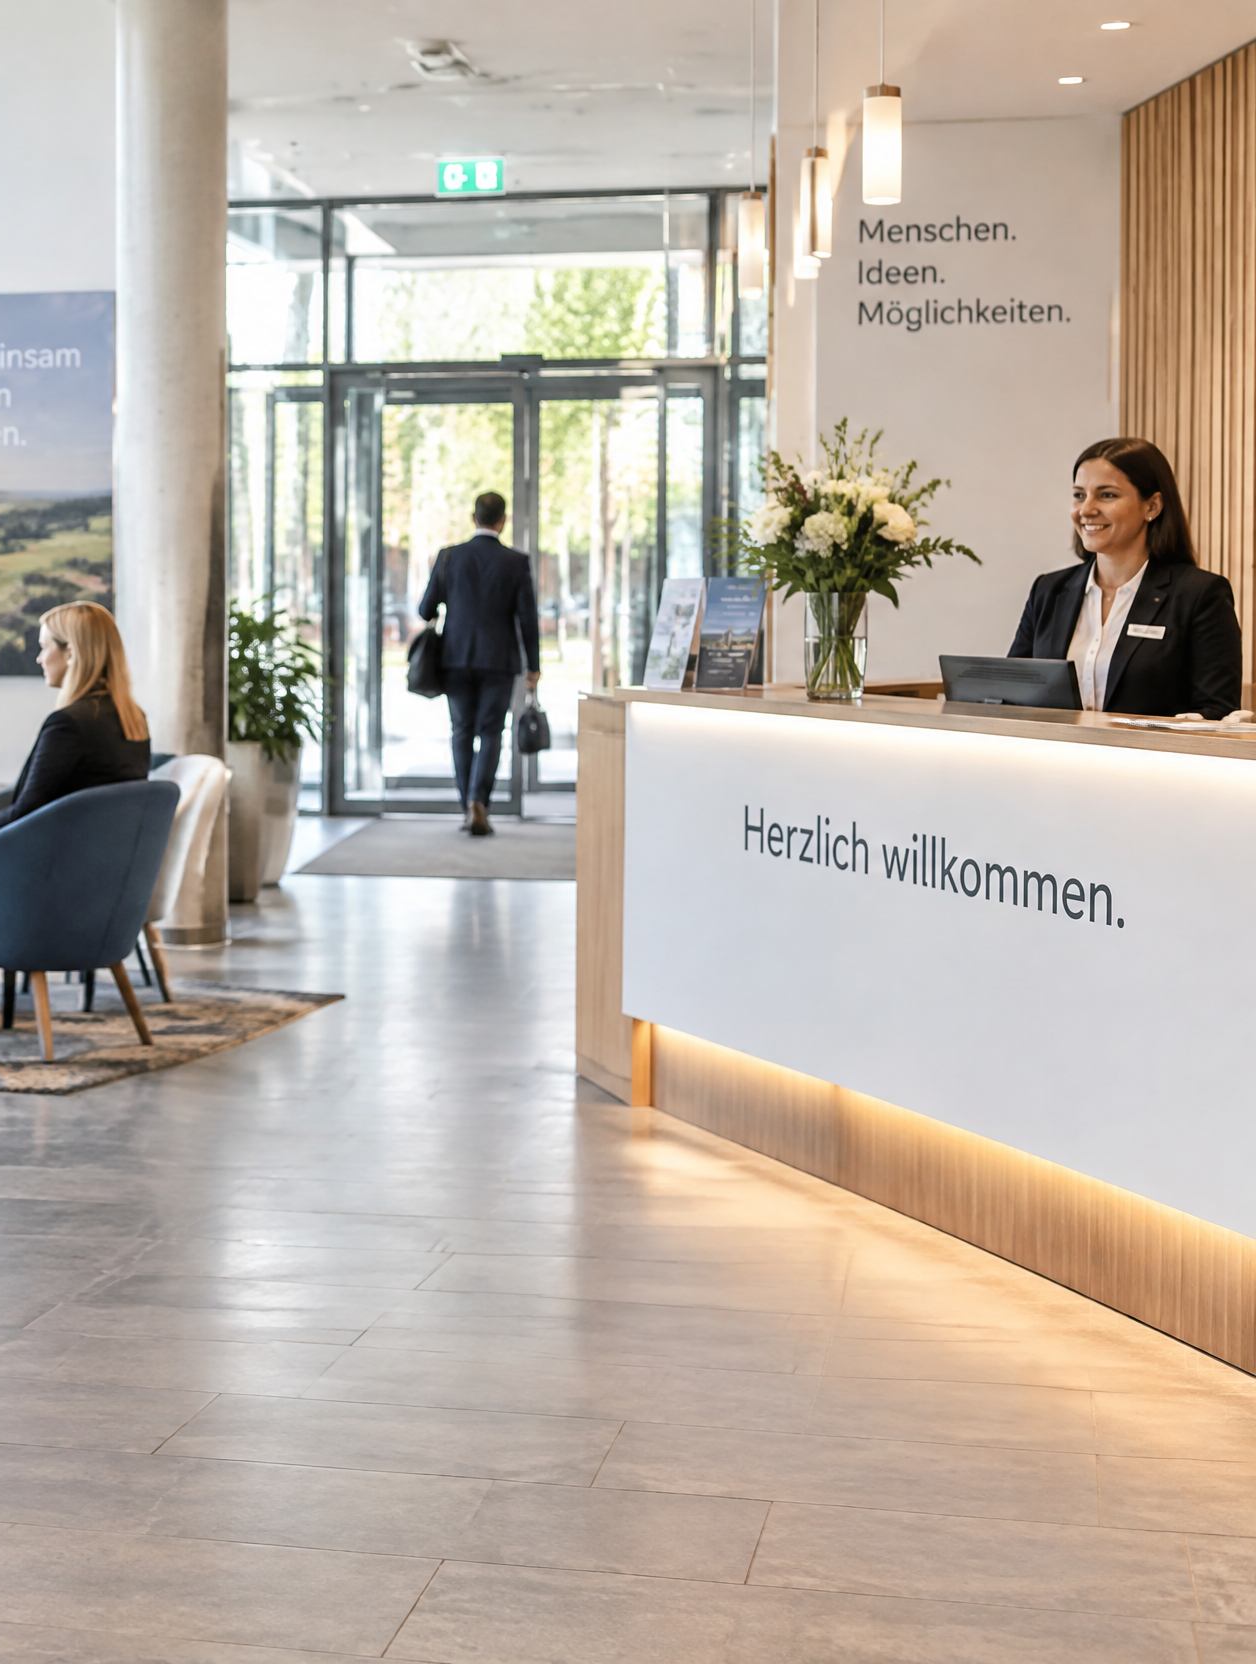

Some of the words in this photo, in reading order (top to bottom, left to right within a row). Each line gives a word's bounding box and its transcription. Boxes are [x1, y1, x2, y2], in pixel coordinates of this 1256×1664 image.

[859, 215, 1017, 244] Menschen.
[857, 258, 946, 286] Ideen.
[858, 297, 1071, 333] Möglichkeiten.
[744, 804, 869, 875] Herzlich
[881, 833, 1125, 929] willkommen.
